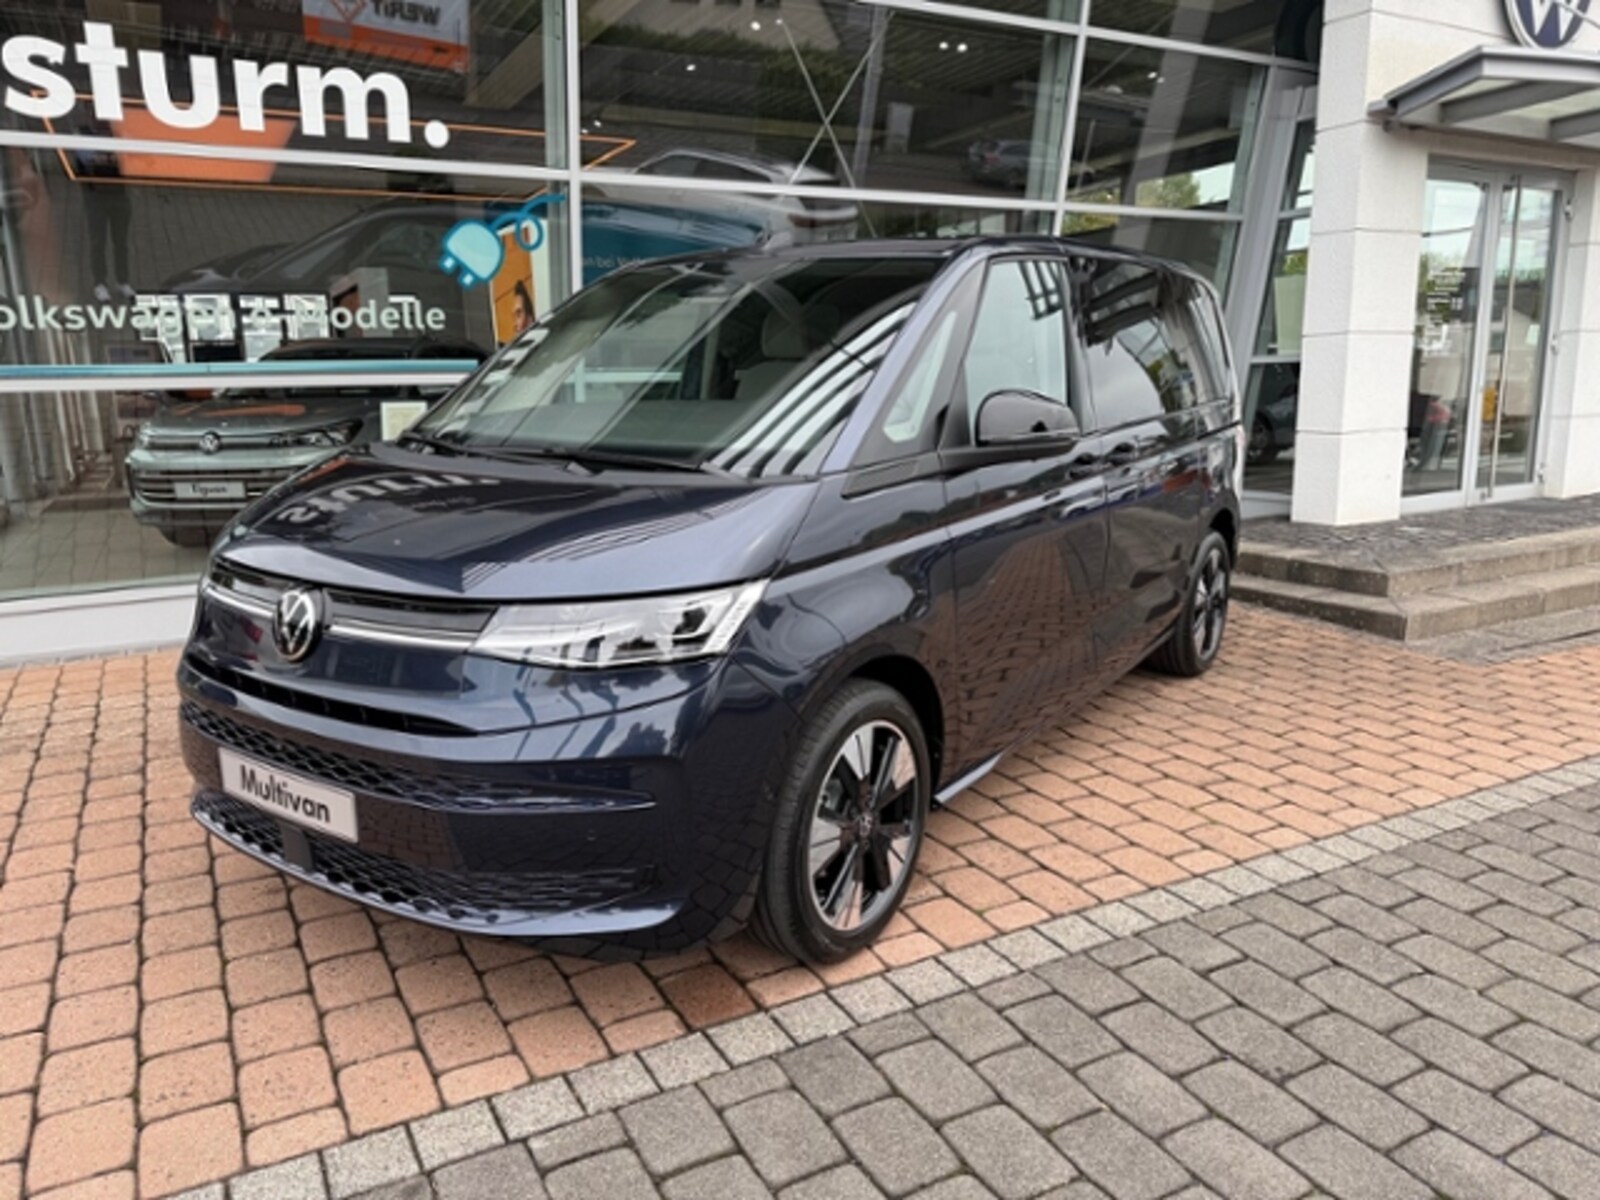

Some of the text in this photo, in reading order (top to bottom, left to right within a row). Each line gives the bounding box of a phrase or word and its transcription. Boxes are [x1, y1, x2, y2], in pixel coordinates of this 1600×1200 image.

[1, 20, 450, 148] sturm.
[0, 294, 236, 337] olkswagen
[240, 764, 331, 824] Multivan
